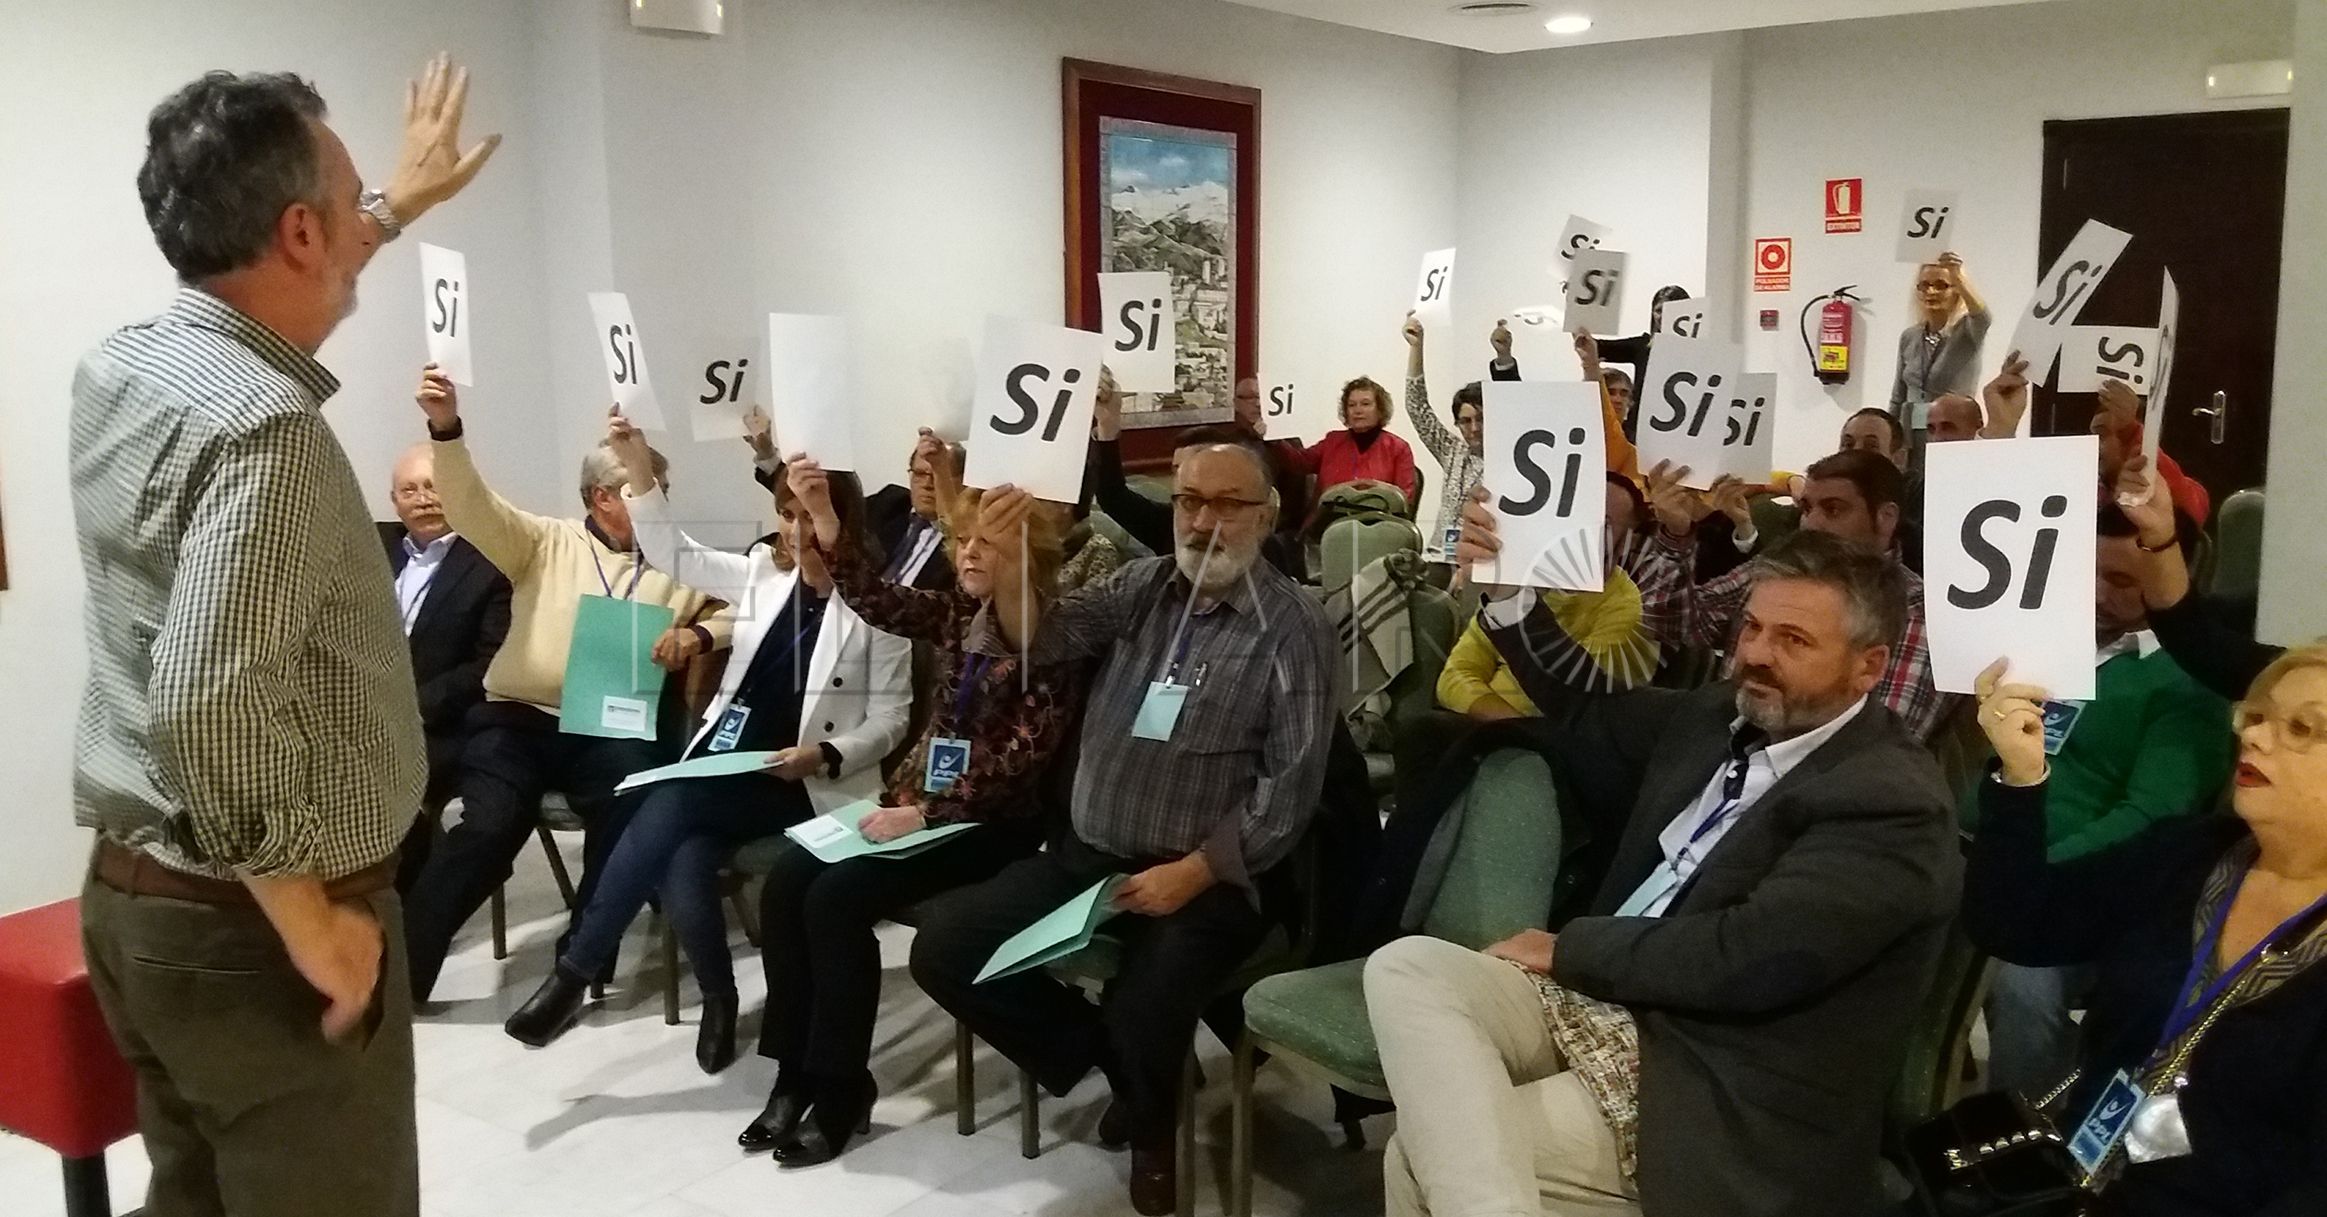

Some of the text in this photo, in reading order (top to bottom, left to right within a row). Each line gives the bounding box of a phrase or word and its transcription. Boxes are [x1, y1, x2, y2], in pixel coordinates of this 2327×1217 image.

[1906, 206, 1949, 239] Si
[432, 278, 460, 338] Si
[1420, 265, 1449, 302] Si
[1574, 269, 1620, 307] Si
[2032, 260, 2103, 326] Si
[1114, 298, 1162, 352] Si
[609, 323, 638, 385] Si
[699, 358, 749, 405] Si
[2096, 336, 2145, 385] Si
[989, 363, 1081, 442] Si
[1268, 383, 1294, 417] Si
[1649, 371, 1722, 437] Si
[1499, 427, 1586, 518] Si
[1944, 494, 2068, 611] Si
